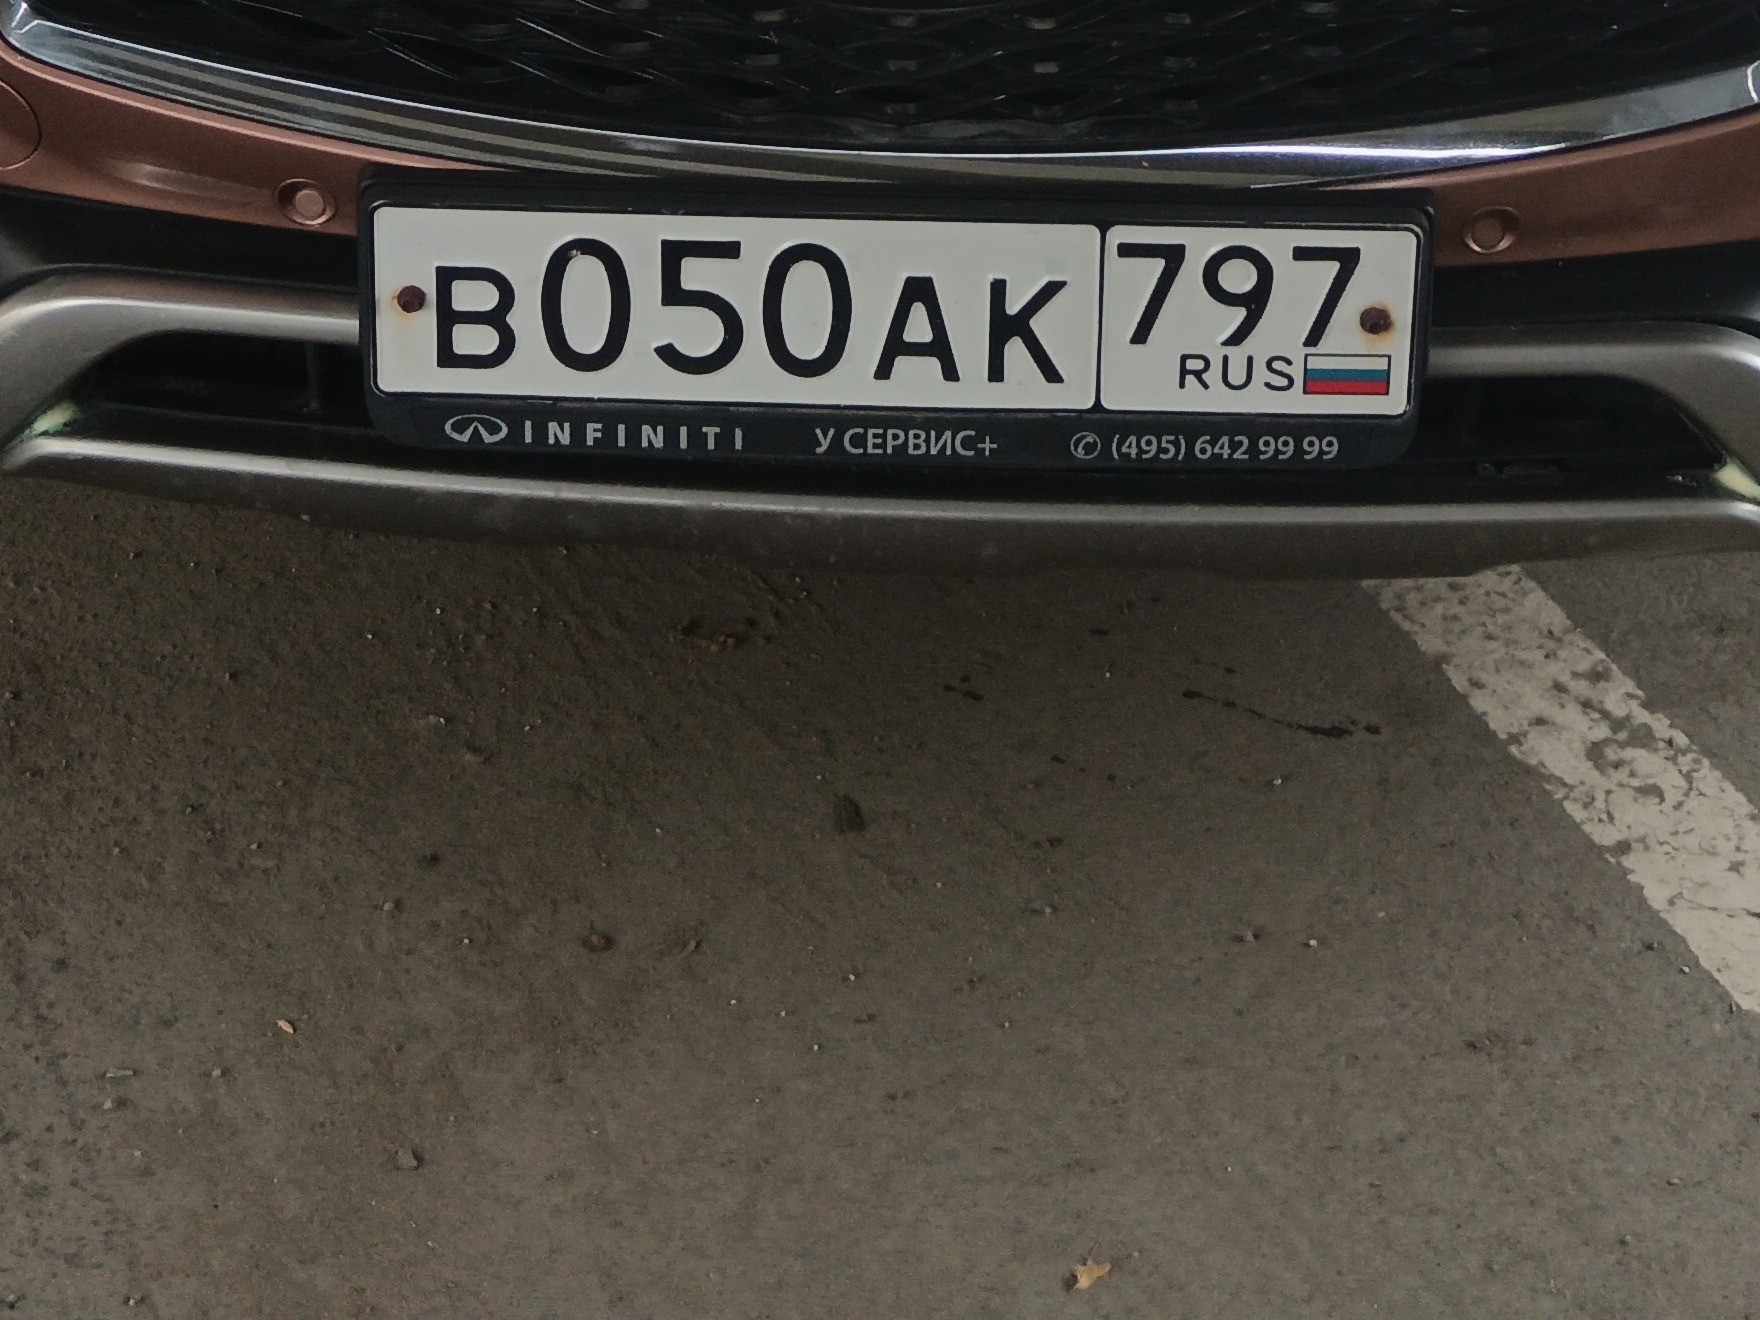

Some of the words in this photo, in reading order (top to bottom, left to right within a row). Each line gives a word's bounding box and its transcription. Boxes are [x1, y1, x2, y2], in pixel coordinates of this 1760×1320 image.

[434, 236, 1069, 384] В050АК
[1116, 241, 1361, 348] 797
[1177, 353, 1295, 392] RUS
[524, 420, 743, 451] INFINITI
[843, 427, 998, 458] СЕРВИС+
[1111, 434, 1186, 461] (495)
[1194, 435, 1250, 460] 642
[1258, 435, 1295, 460] 99
[1302, 435, 1340, 460] 99
